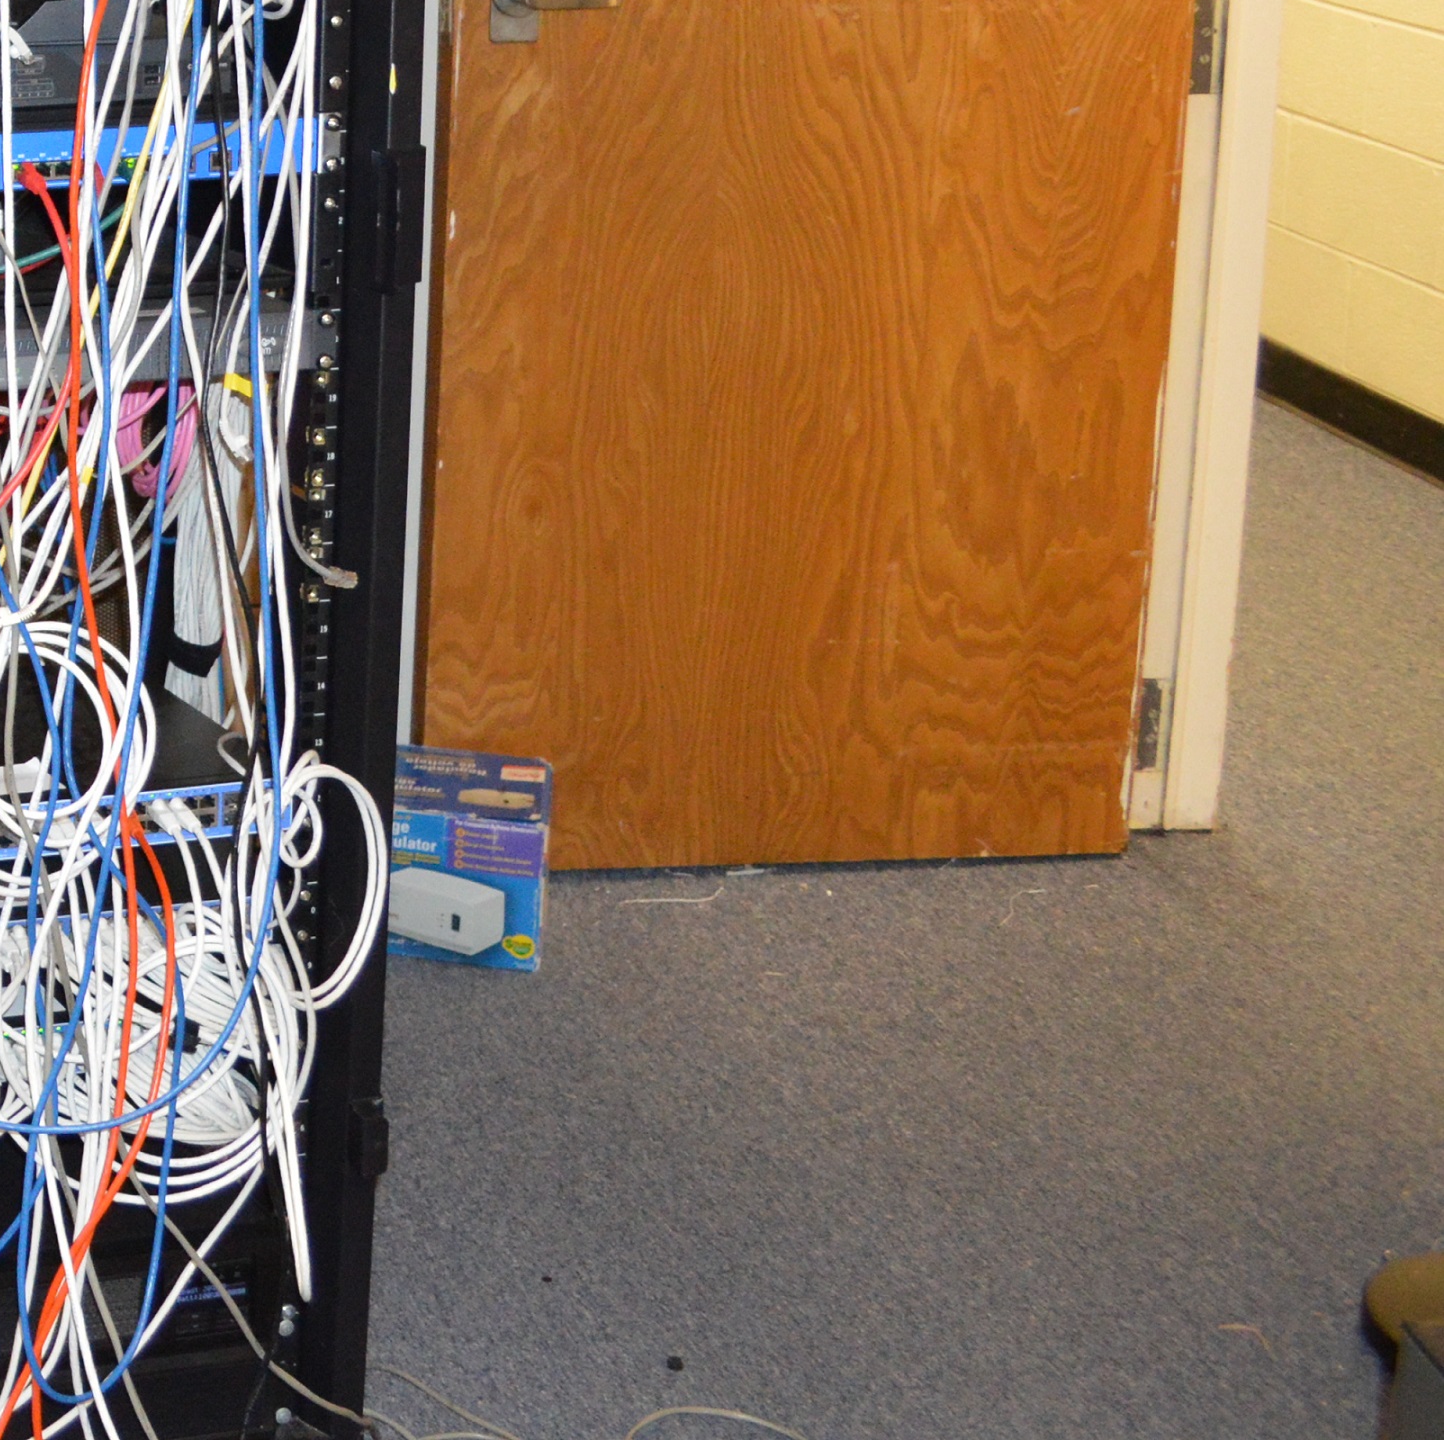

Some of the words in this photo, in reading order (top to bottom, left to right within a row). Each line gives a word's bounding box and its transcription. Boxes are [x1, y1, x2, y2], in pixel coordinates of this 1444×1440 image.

[328, 393, 336, 402] 19
[326, 452, 335, 460] 18
[324, 510, 333, 518] 17
[393, 835, 437, 852] ulator
